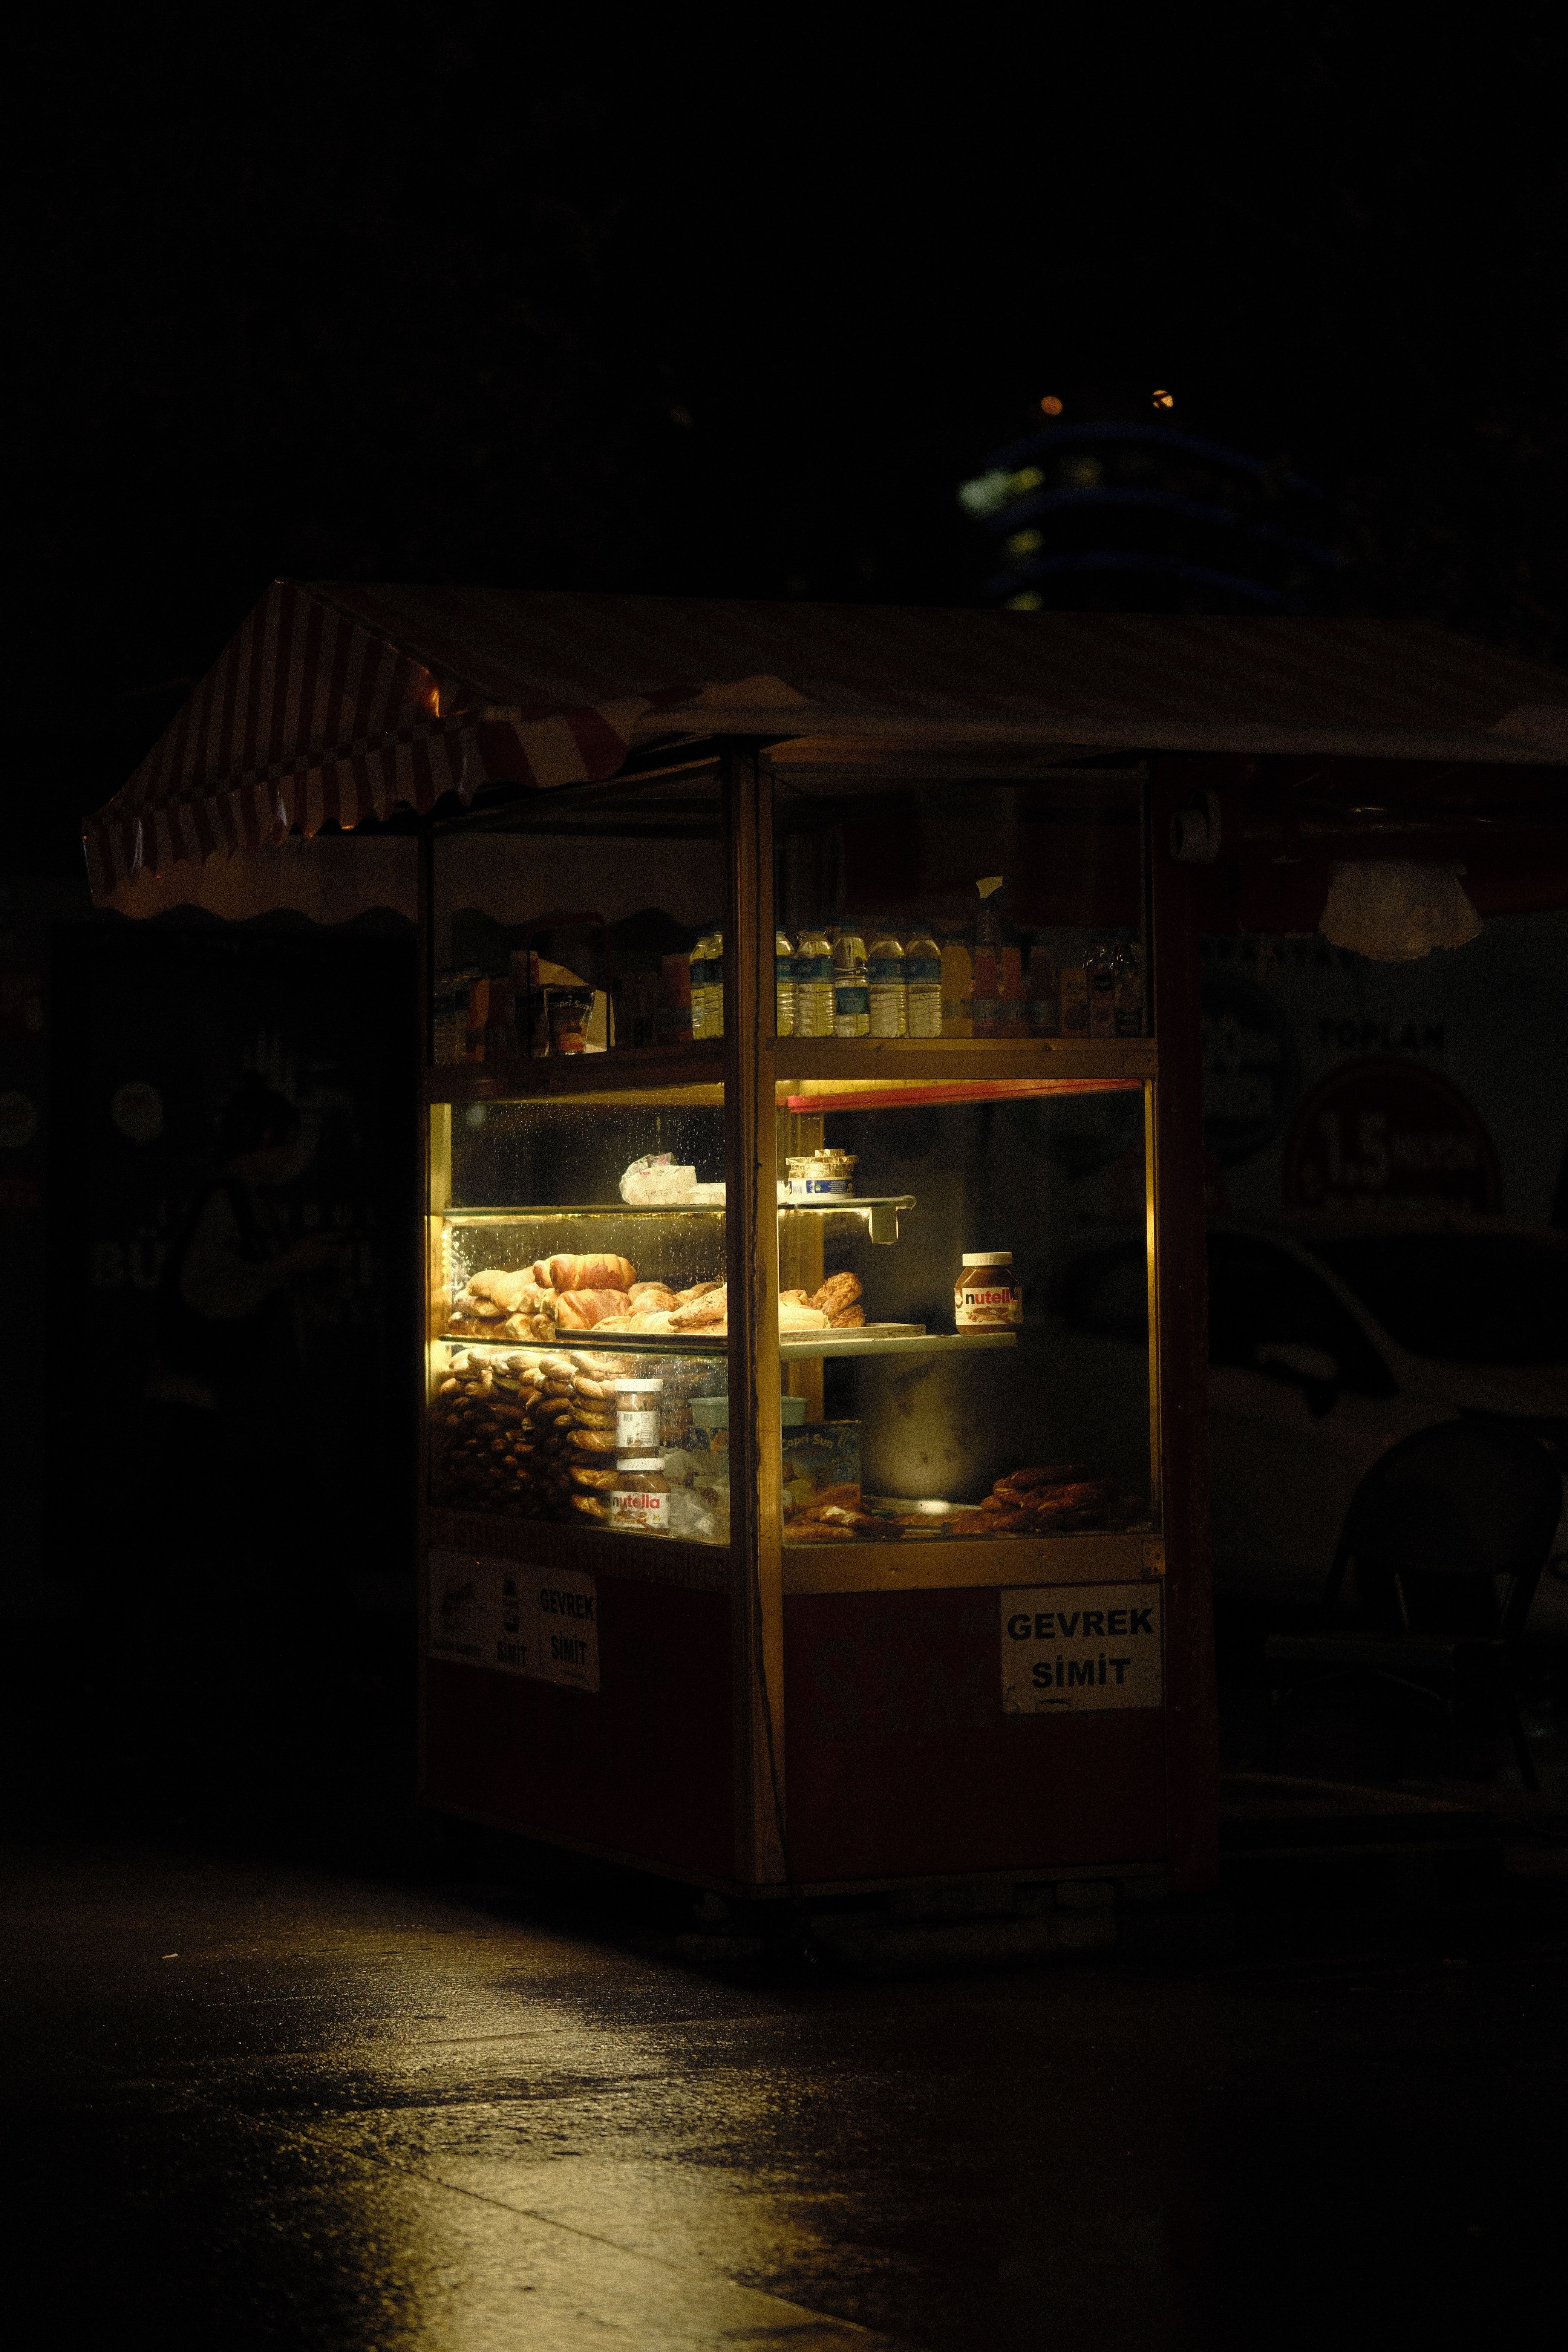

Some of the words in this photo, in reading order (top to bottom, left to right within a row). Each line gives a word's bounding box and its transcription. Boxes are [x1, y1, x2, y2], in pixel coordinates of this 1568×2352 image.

[965, 1288, 1012, 1305] nutell
[612, 1493, 660, 1508] nutella
[540, 1588, 594, 1620] GEVREK
[1008, 1608, 1154, 1640] GEVREK
[497, 1638, 527, 1666] SİMİT
[551, 1630, 587, 1665] SİMİT
[1032, 1653, 1131, 1689] SİMİT
